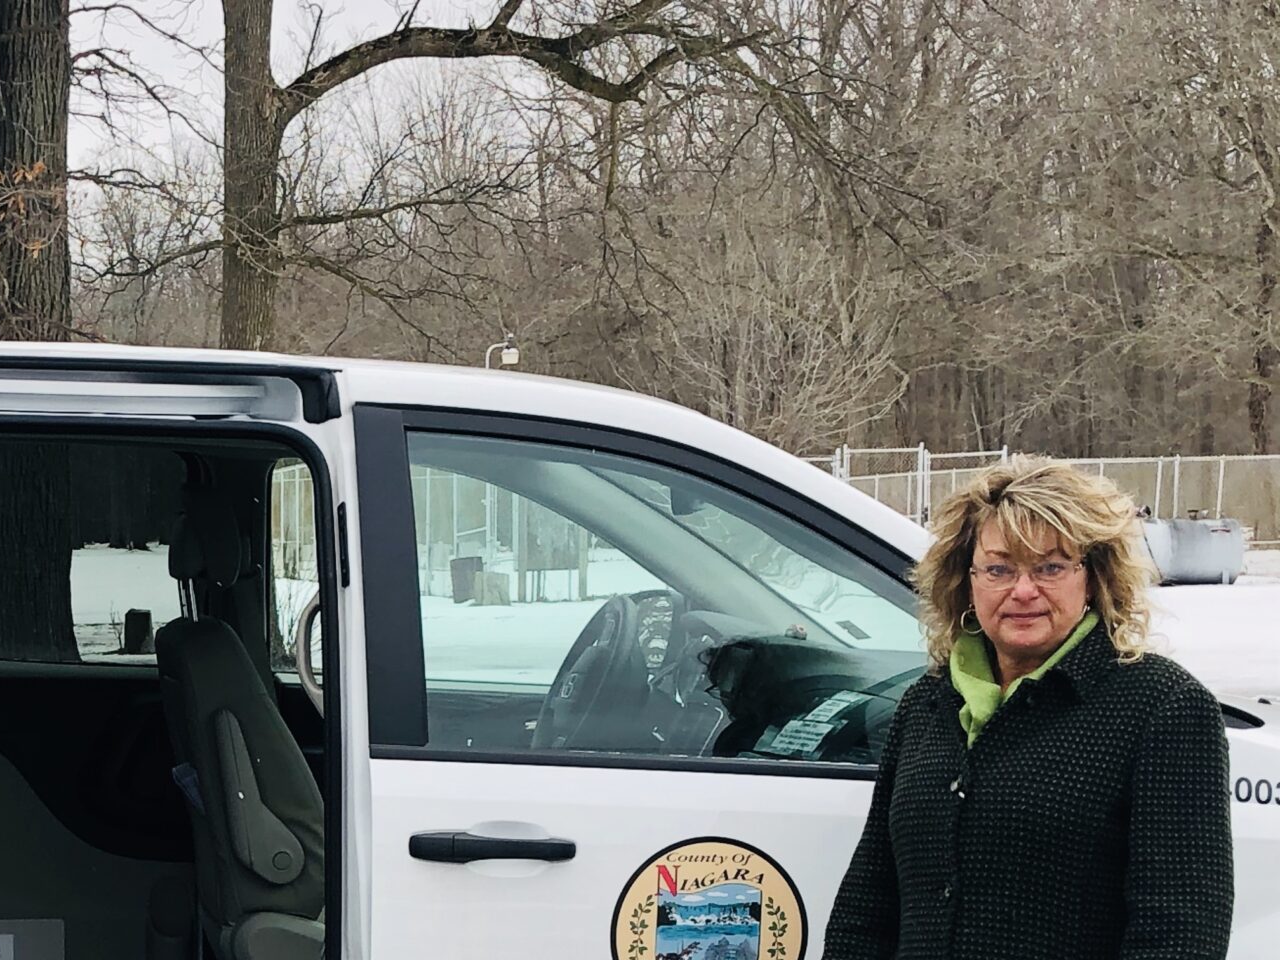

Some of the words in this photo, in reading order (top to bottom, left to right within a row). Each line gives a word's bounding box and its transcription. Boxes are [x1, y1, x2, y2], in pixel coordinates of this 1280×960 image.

[666, 852, 728, 866] County
[731, 853, 755, 866] Of
[654, 864, 766, 897] NIAGARA
